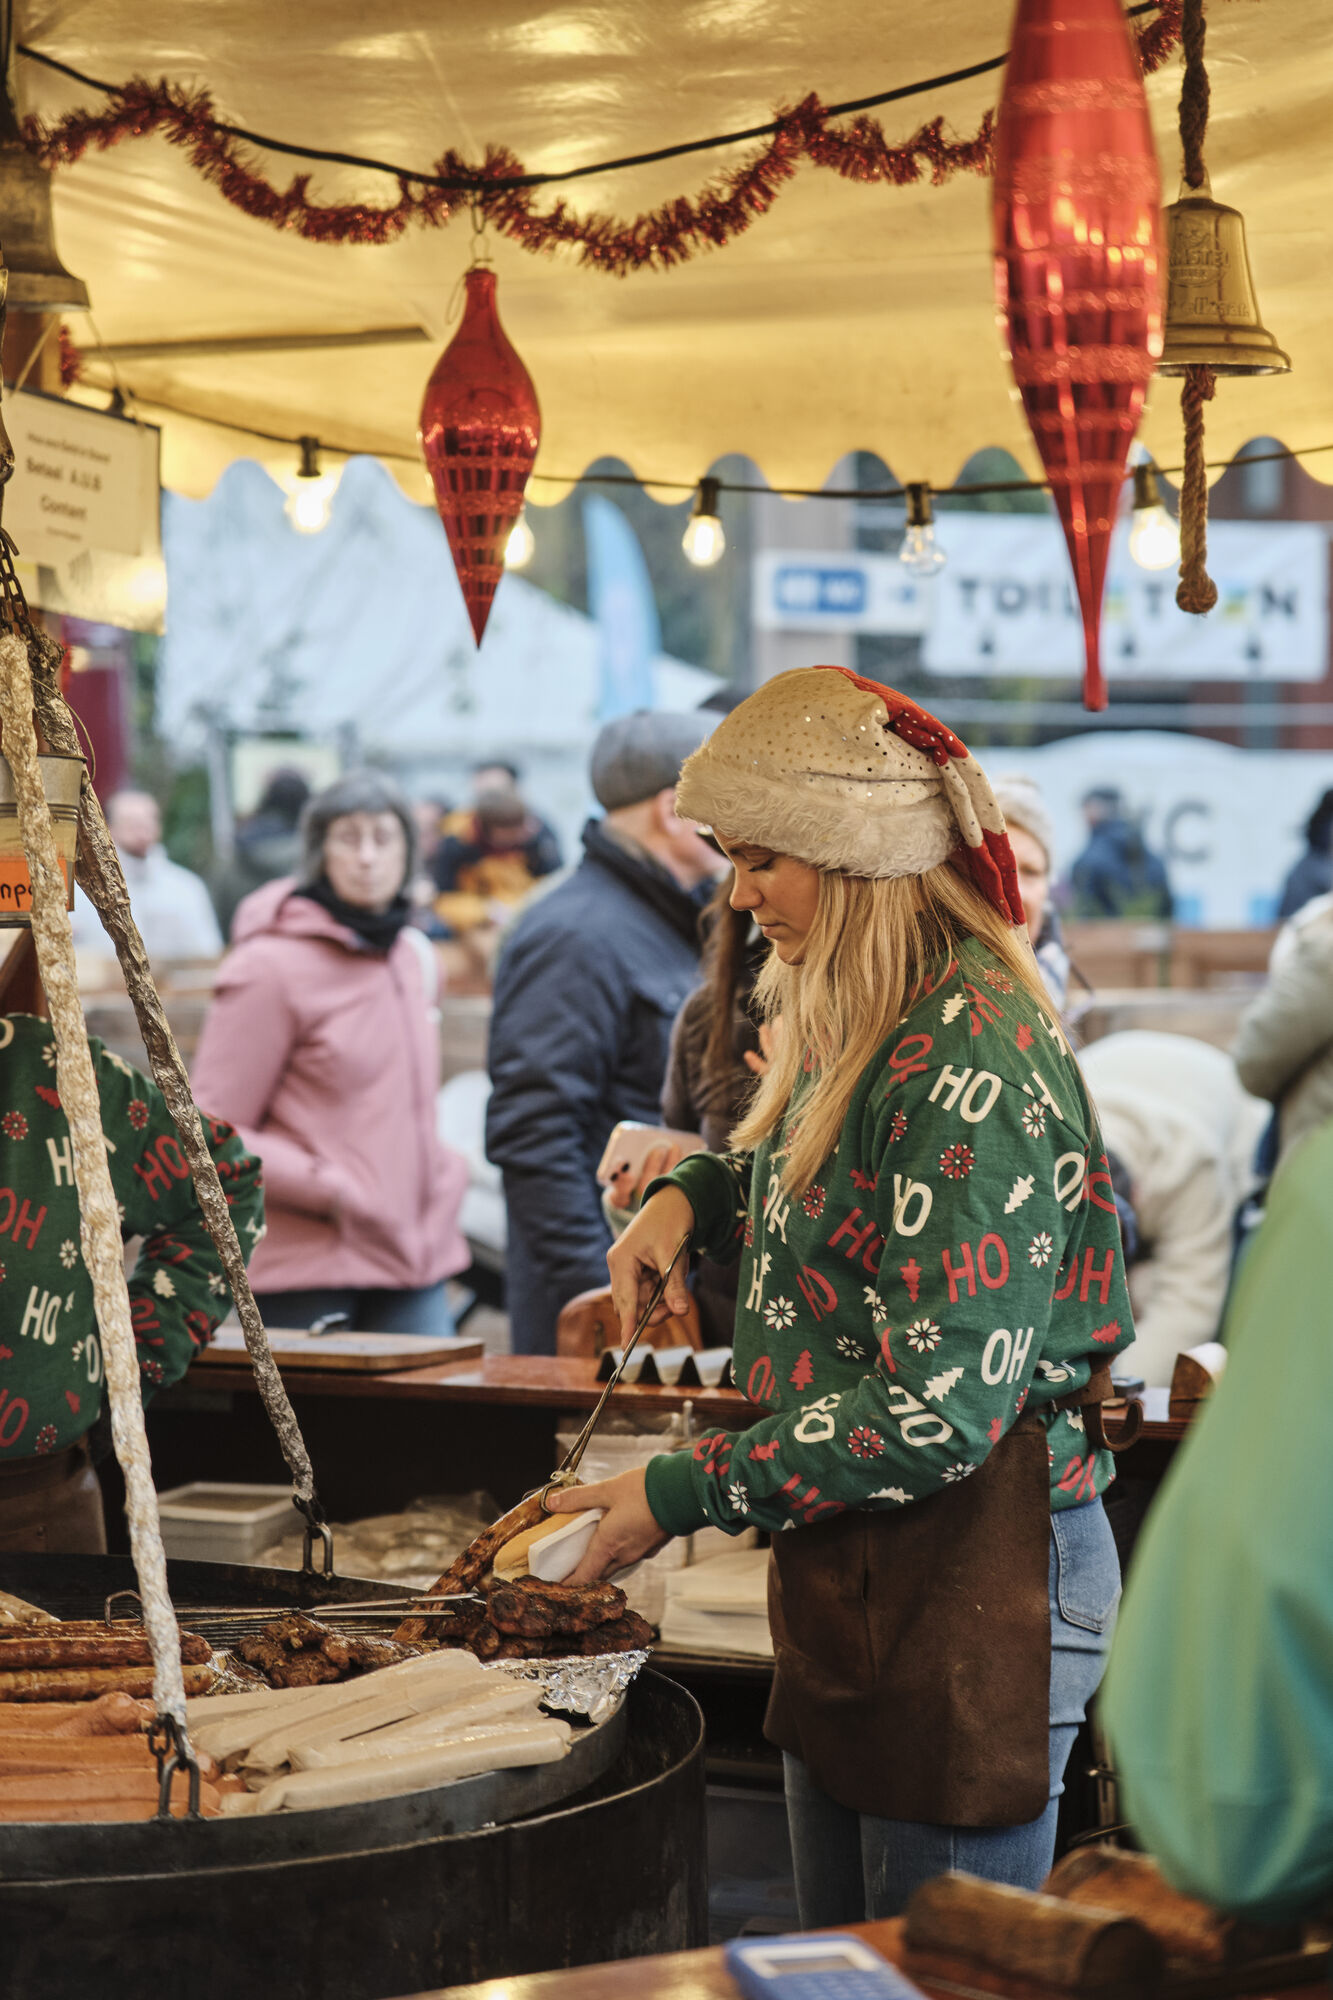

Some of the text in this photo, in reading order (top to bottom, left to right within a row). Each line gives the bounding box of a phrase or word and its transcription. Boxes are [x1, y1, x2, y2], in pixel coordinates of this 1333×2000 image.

[928, 1064, 1002, 1123] HO
[132, 1134, 191, 1200] HO
[941, 1232, 1011, 1305] HO
[20, 1285, 63, 1346] HO
[980, 1326, 1035, 1386] OH
